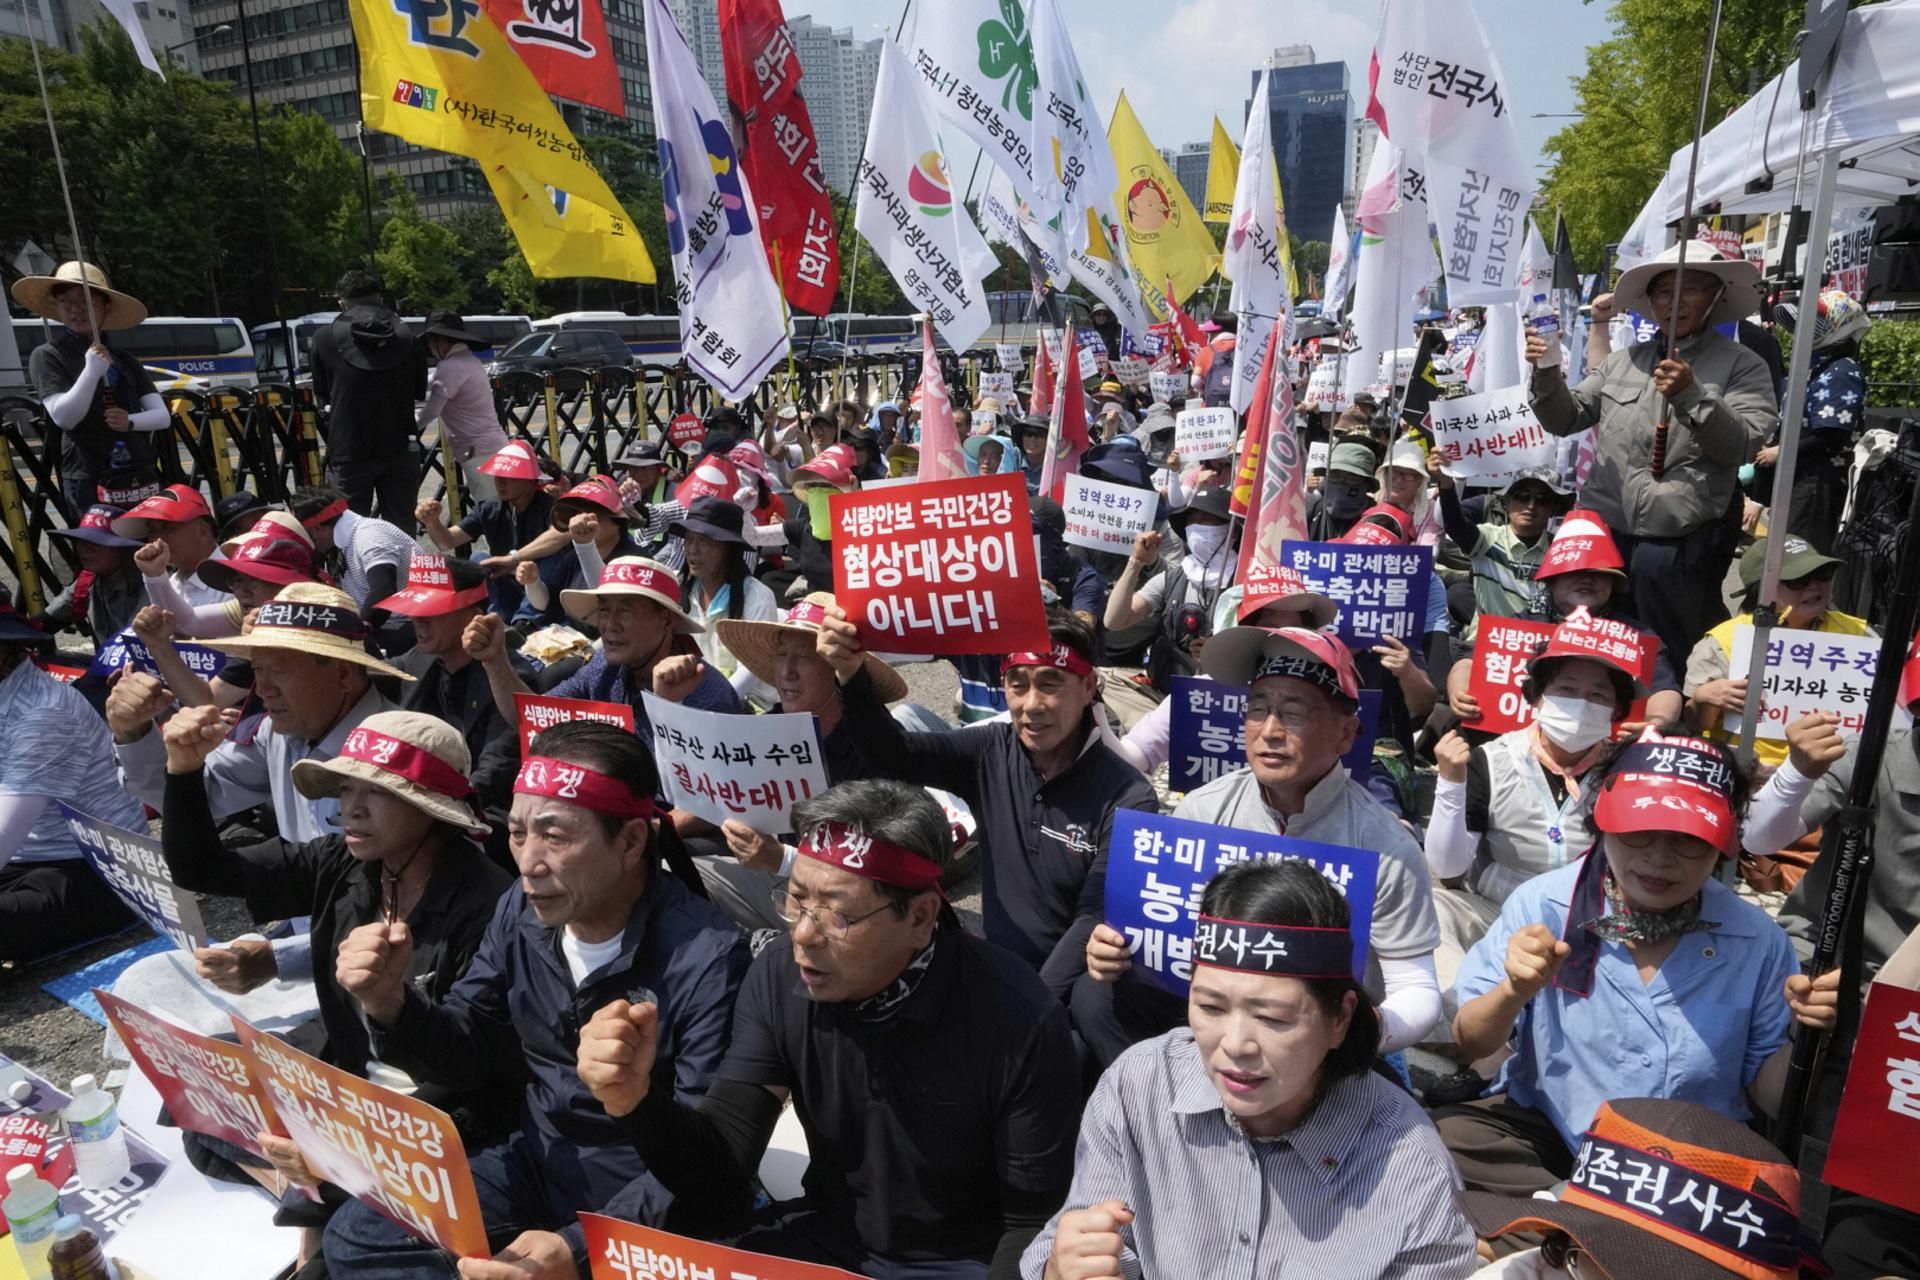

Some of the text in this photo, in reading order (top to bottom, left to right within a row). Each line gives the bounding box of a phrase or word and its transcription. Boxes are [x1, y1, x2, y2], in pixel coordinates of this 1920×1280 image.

[178, 361, 215, 372] POLICE
[1434, 413, 1479, 434] 미국산
[1484, 405, 1512, 425] 사과
[1444, 424, 1545, 462] 결사반대!!
[841, 490, 1013, 537] 식량안보 국민건강
[1078, 487, 1143, 513] 검역완화?
[1068, 506, 1147, 533] 소비자 안전을 위해
[842, 531, 1019, 589] 협상대상이
[1343, 553, 1421, 575] 관세협상
[867, 590, 999, 637] 아니다!
[1351, 610, 1415, 639] 반대!
[1592, 617, 1639, 644] 키워서
[1558, 631, 1639, 662] 남는건 소똥뿐
[656, 723, 813, 767] 미국산 사과 수입
[1132, 828, 1206, 872] 한·미
[251, 1038, 444, 1160] 식량안보 국민건강
